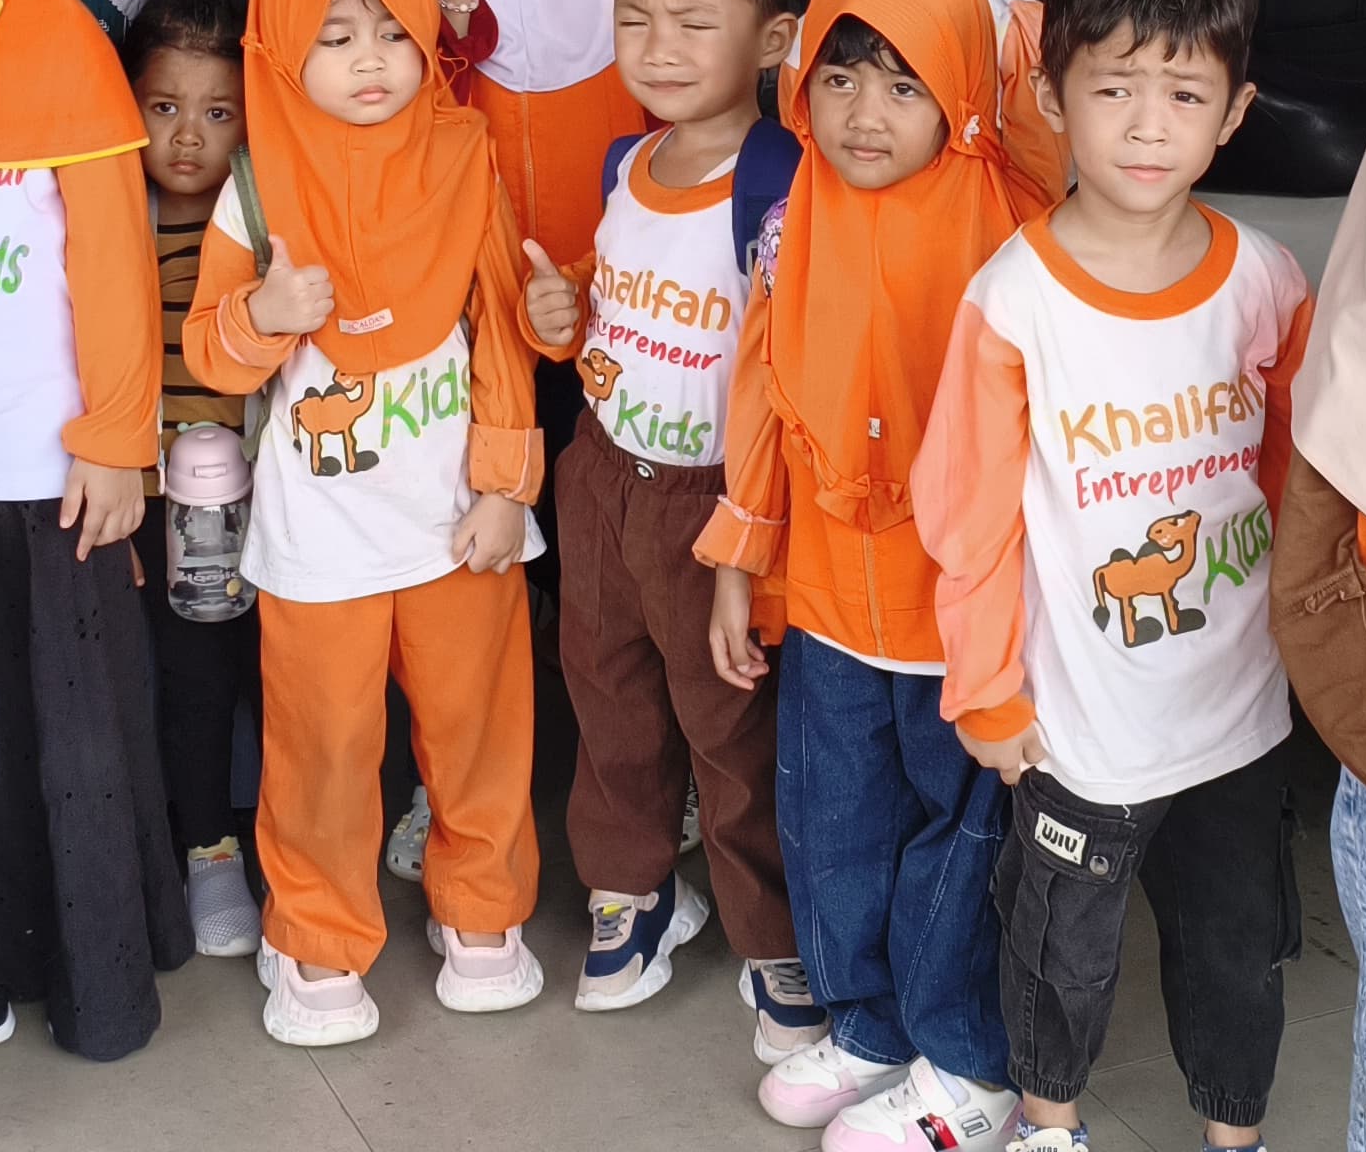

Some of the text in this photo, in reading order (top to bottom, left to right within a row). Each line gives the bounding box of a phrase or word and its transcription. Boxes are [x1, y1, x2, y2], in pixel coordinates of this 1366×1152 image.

[613, 388, 712, 458] Kids
[1059, 371, 1265, 464] Khalifah
[1075, 443, 1262, 510] Entrepreneu
[1203, 499, 1273, 605] Kids
